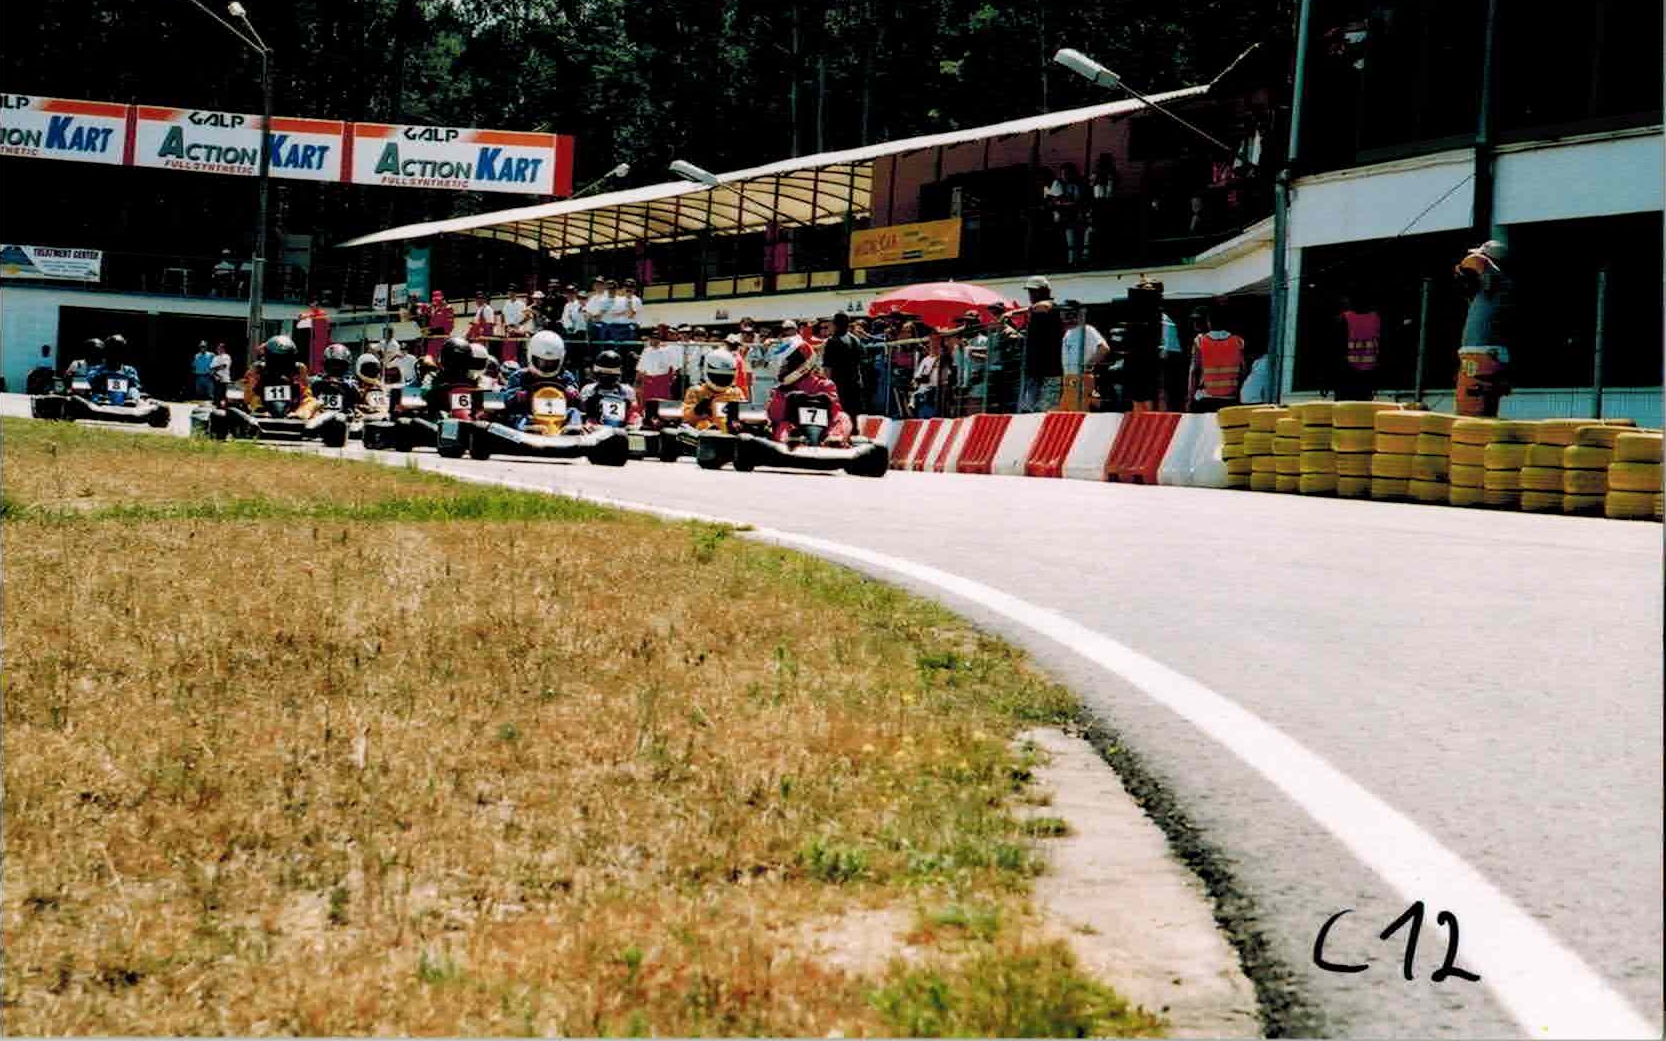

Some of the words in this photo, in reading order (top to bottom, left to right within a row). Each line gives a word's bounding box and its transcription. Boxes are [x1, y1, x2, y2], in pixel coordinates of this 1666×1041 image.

[188, 111, 245, 128] GALP
[403, 127, 459, 142] GALP
[270, 385, 286, 399] 11
[458, 394, 469, 407] 6
[609, 403, 619, 416] 2
[806, 409, 818, 423] 7
